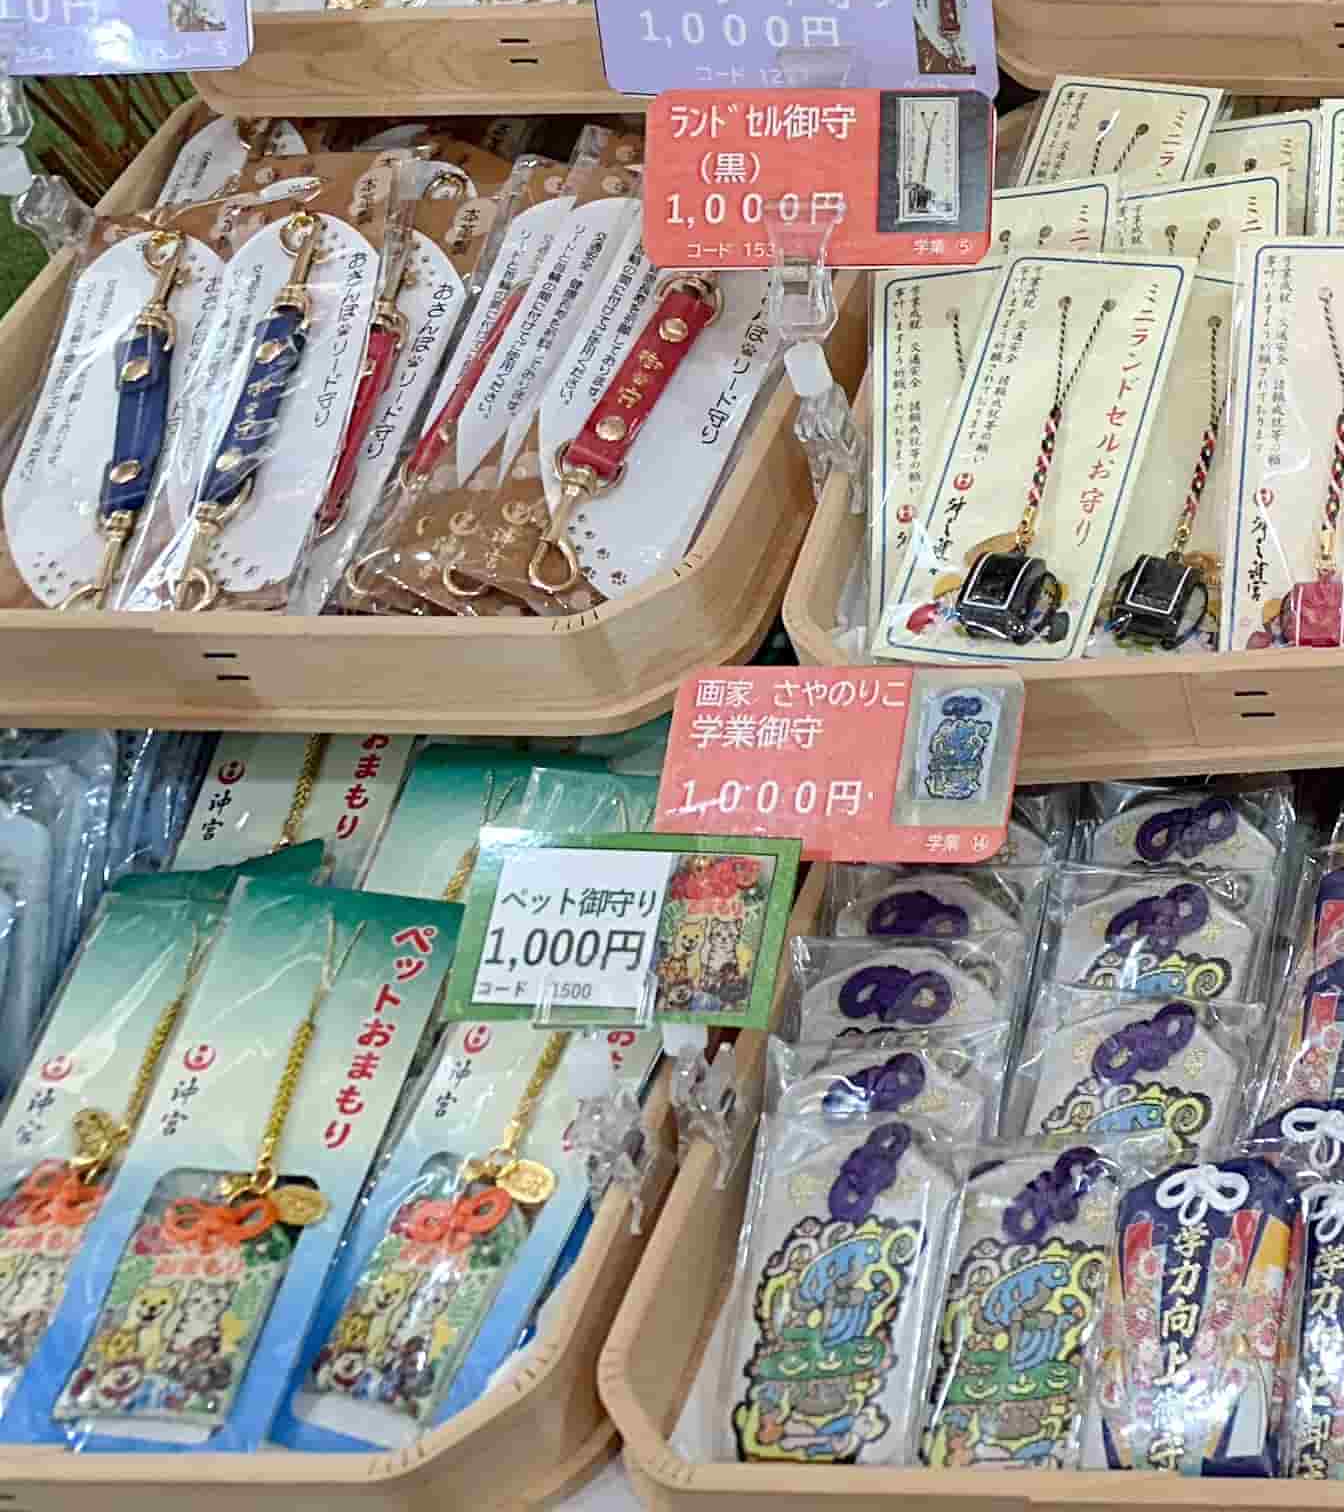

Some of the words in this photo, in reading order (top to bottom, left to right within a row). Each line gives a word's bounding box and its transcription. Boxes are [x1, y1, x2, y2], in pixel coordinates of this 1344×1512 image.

[639, 9, 840, 48] 1,000円
[701, 151, 761, 185] （黒）
[665, 190, 846, 229] 1,000円
[688, 242, 729, 259] コード
[744, 242, 776, 258] 153
[1075, 283, 1163, 547] ミニランドセルお守り
[694, 679, 754, 710] 画家
[773, 679, 906, 710] さやのりこ
[688, 715, 825, 752] 学業御守
[678, 779, 864, 818] 1,000円
[500, 887, 657, 920] ペット御守り
[482, 928, 646, 972] 1,000円
[478, 979, 529, 999] コード
[550, 981, 593, 1000] 1500
[323, 924, 435, 1149] ペットおまもり
